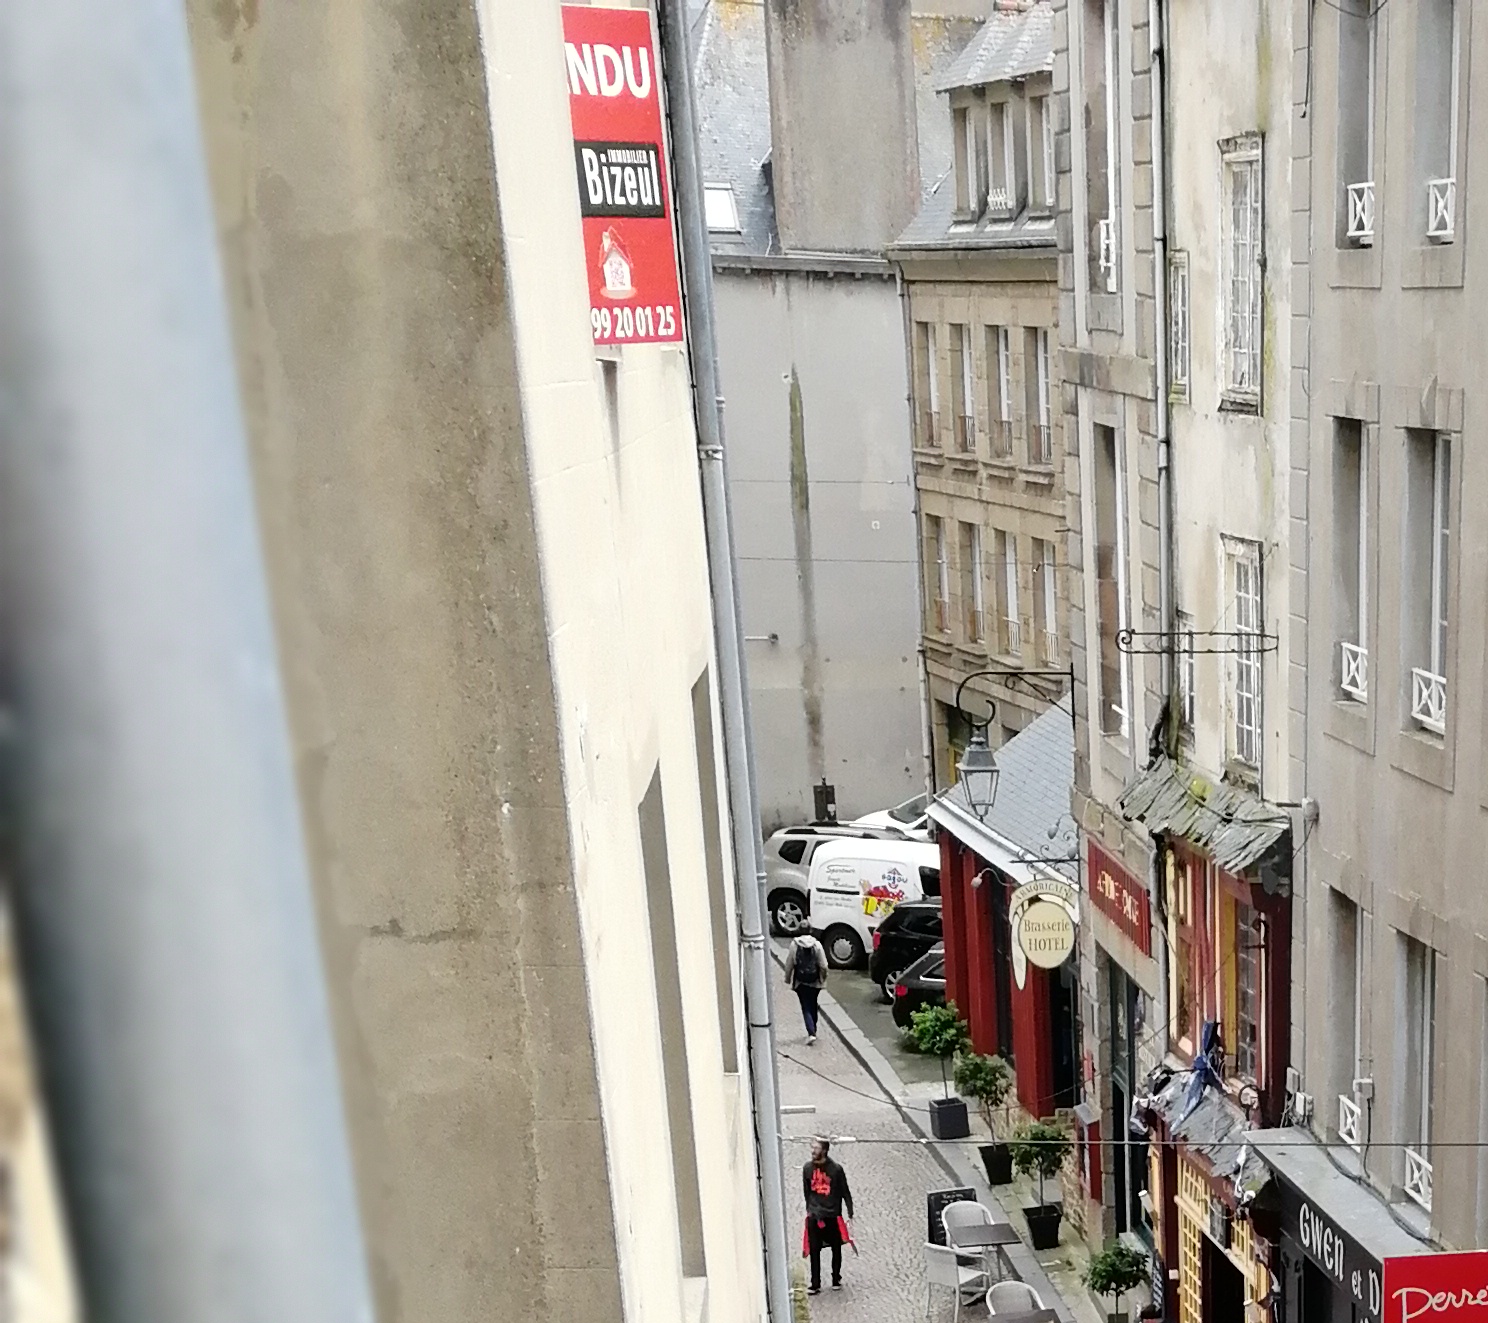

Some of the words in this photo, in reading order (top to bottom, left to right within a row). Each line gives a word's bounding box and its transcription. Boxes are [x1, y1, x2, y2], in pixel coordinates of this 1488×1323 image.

[564, 42, 651, 99] NDU
[607, 149, 648, 163] IMMOBILIER
[582, 148, 661, 206] Bizeul
[591, 307, 612, 339] 99
[613, 307, 634, 338] 20
[635, 306, 654, 337] 01
[655, 305, 676, 336] 25
[1024, 918, 1070, 933] Brasserie
[1028, 938, 1069, 951] HOTEL
[1368, 1268, 1381, 1316] D
